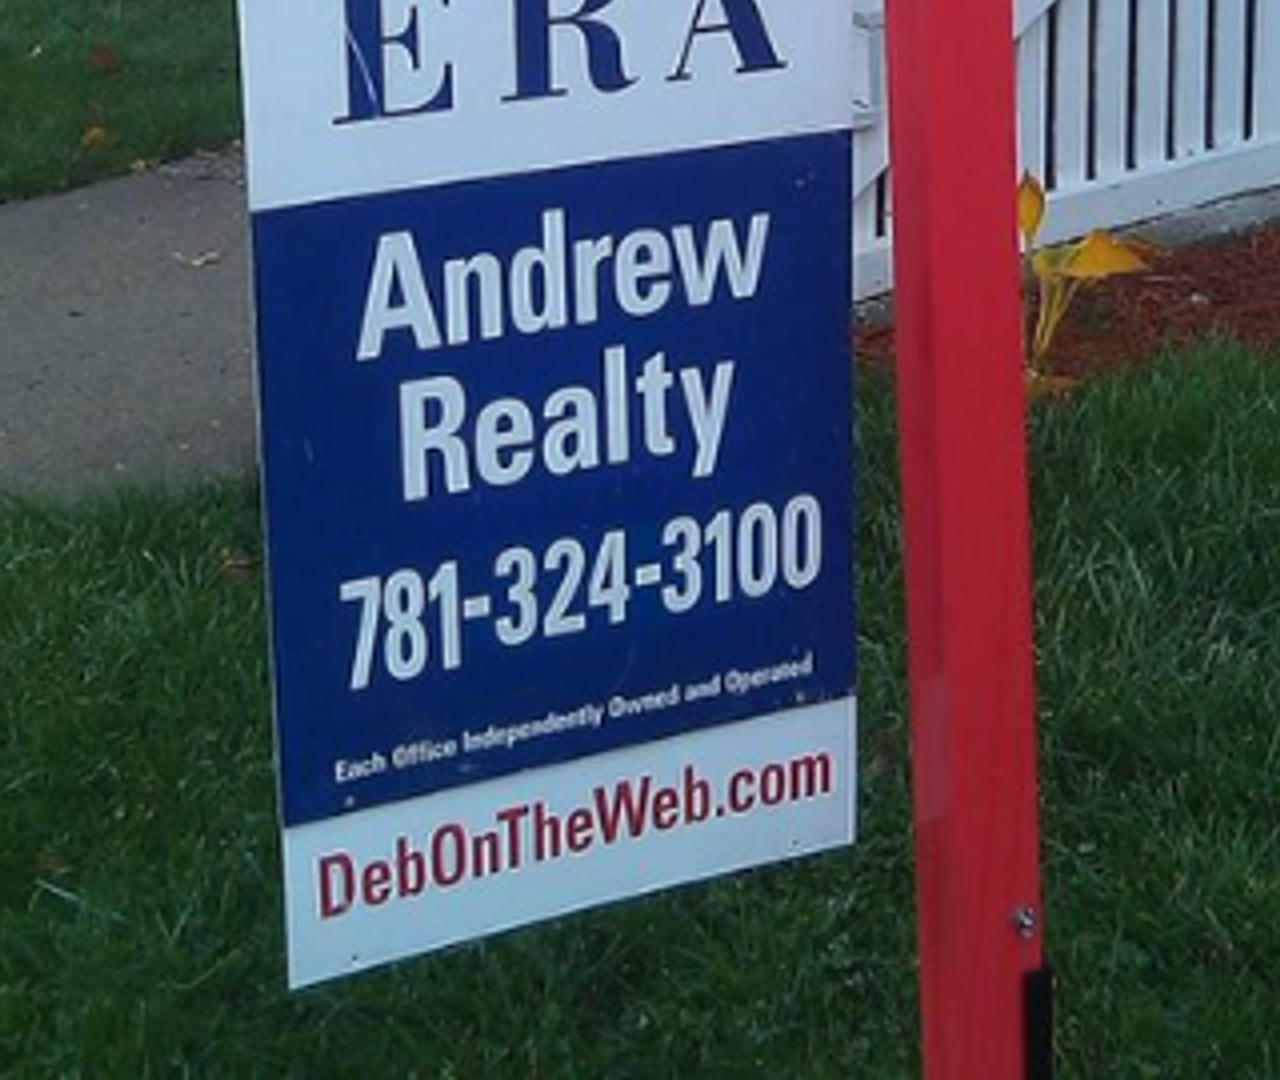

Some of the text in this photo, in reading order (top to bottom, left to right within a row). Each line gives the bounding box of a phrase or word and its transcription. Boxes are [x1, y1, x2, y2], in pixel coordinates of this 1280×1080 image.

[356, 208, 771, 362] Andrew
[398, 345, 734, 503] Realty
[339, 493, 823, 691] 781-324-3100
[334, 652, 814, 783] Each Office Independently Owned and Operated
[318, 750, 831, 921] DebOnTheWeb.com
